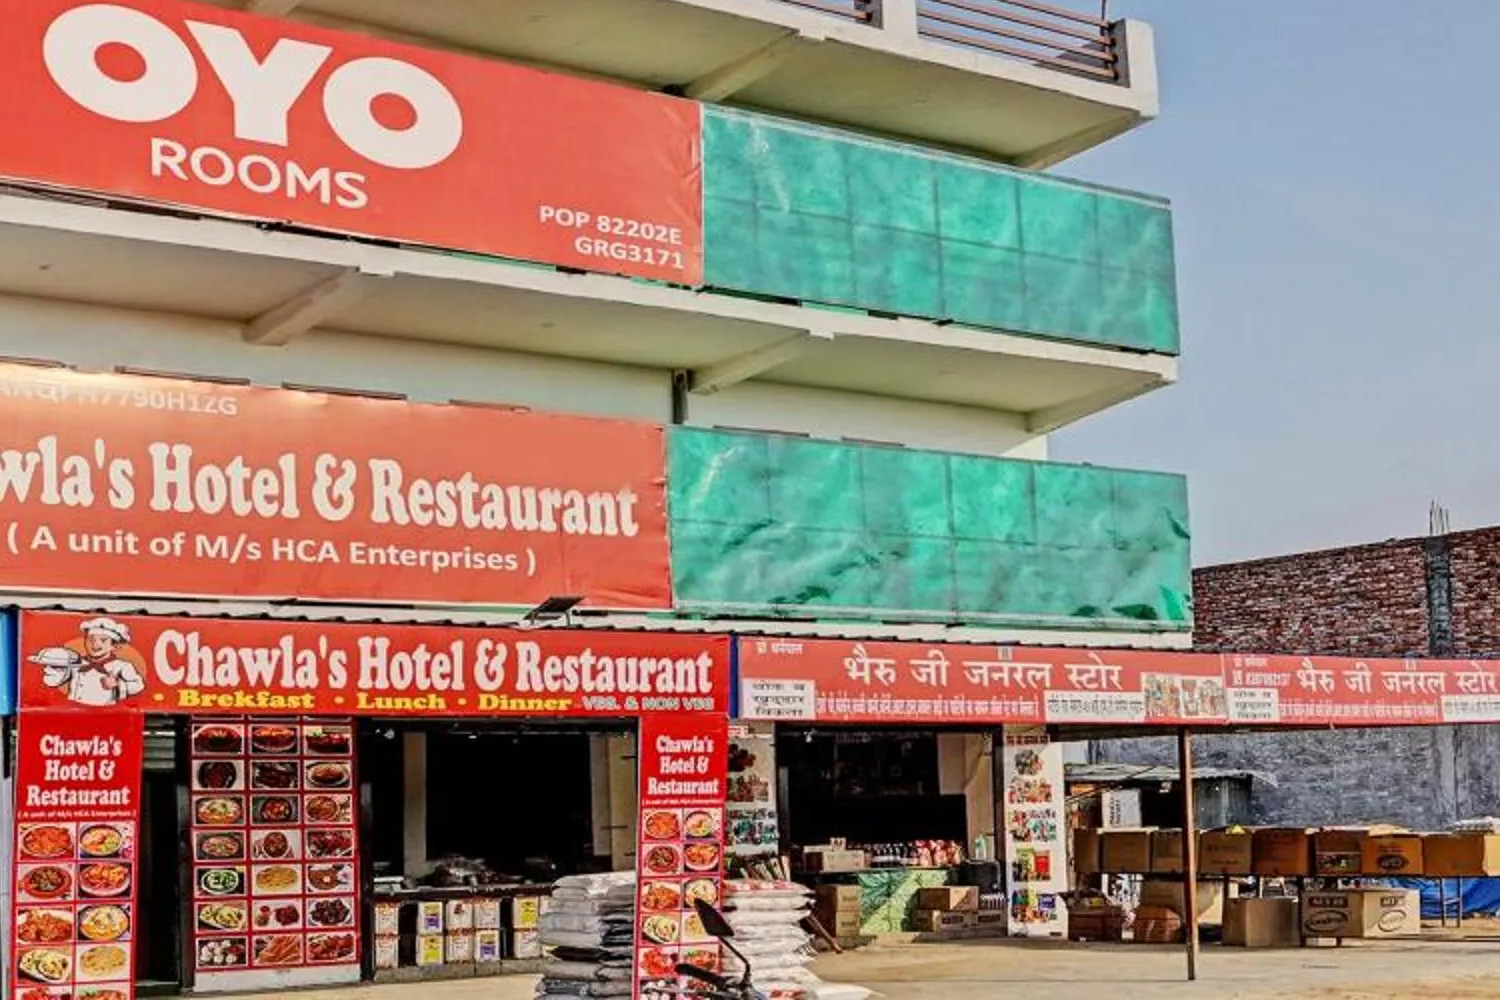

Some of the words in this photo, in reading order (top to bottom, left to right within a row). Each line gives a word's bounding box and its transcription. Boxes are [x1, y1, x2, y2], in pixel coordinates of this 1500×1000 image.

[42, 2, 463, 169] OYO
[151, 137, 369, 209] ROOMS
[539, 205, 590, 228] POP
[596, 215, 682, 245] 82202E
[574, 236, 684, 269] GRG3171
[148, 442, 300, 519] Hotel
[311, 452, 357, 521] &
[368, 458, 639, 537] Restaurant
[31, 526, 57, 551] A
[68, 530, 139, 555] unit
[149, 533, 186, 558] of
[195, 535, 261, 564] M/s
[272, 539, 340, 563] HCA
[349, 541, 518, 573] Enterprises
[153, 629, 348, 690] Chawla's
[357, 636, 465, 690] Hotel
[473, 638, 507, 691] &
[515, 641, 714, 693] Restaurant
[909, 648, 951, 686] जी
[1065, 651, 1123, 690] स्टोर
[1343, 661, 1373, 693] जी
[177, 688, 315, 709] Brekfast
[356, 692, 447, 710] Lunch
[478, 693, 573, 711] Dinner
[39, 734, 123, 756] Chawla's
[656, 735, 714, 753] Chawla's
[44, 759, 95, 781] Hotel
[98, 759, 115, 781] &
[660, 755, 695, 774] Hotel
[26, 784, 130, 806] Restaurant
[647, 777, 719, 796] Restaurant
